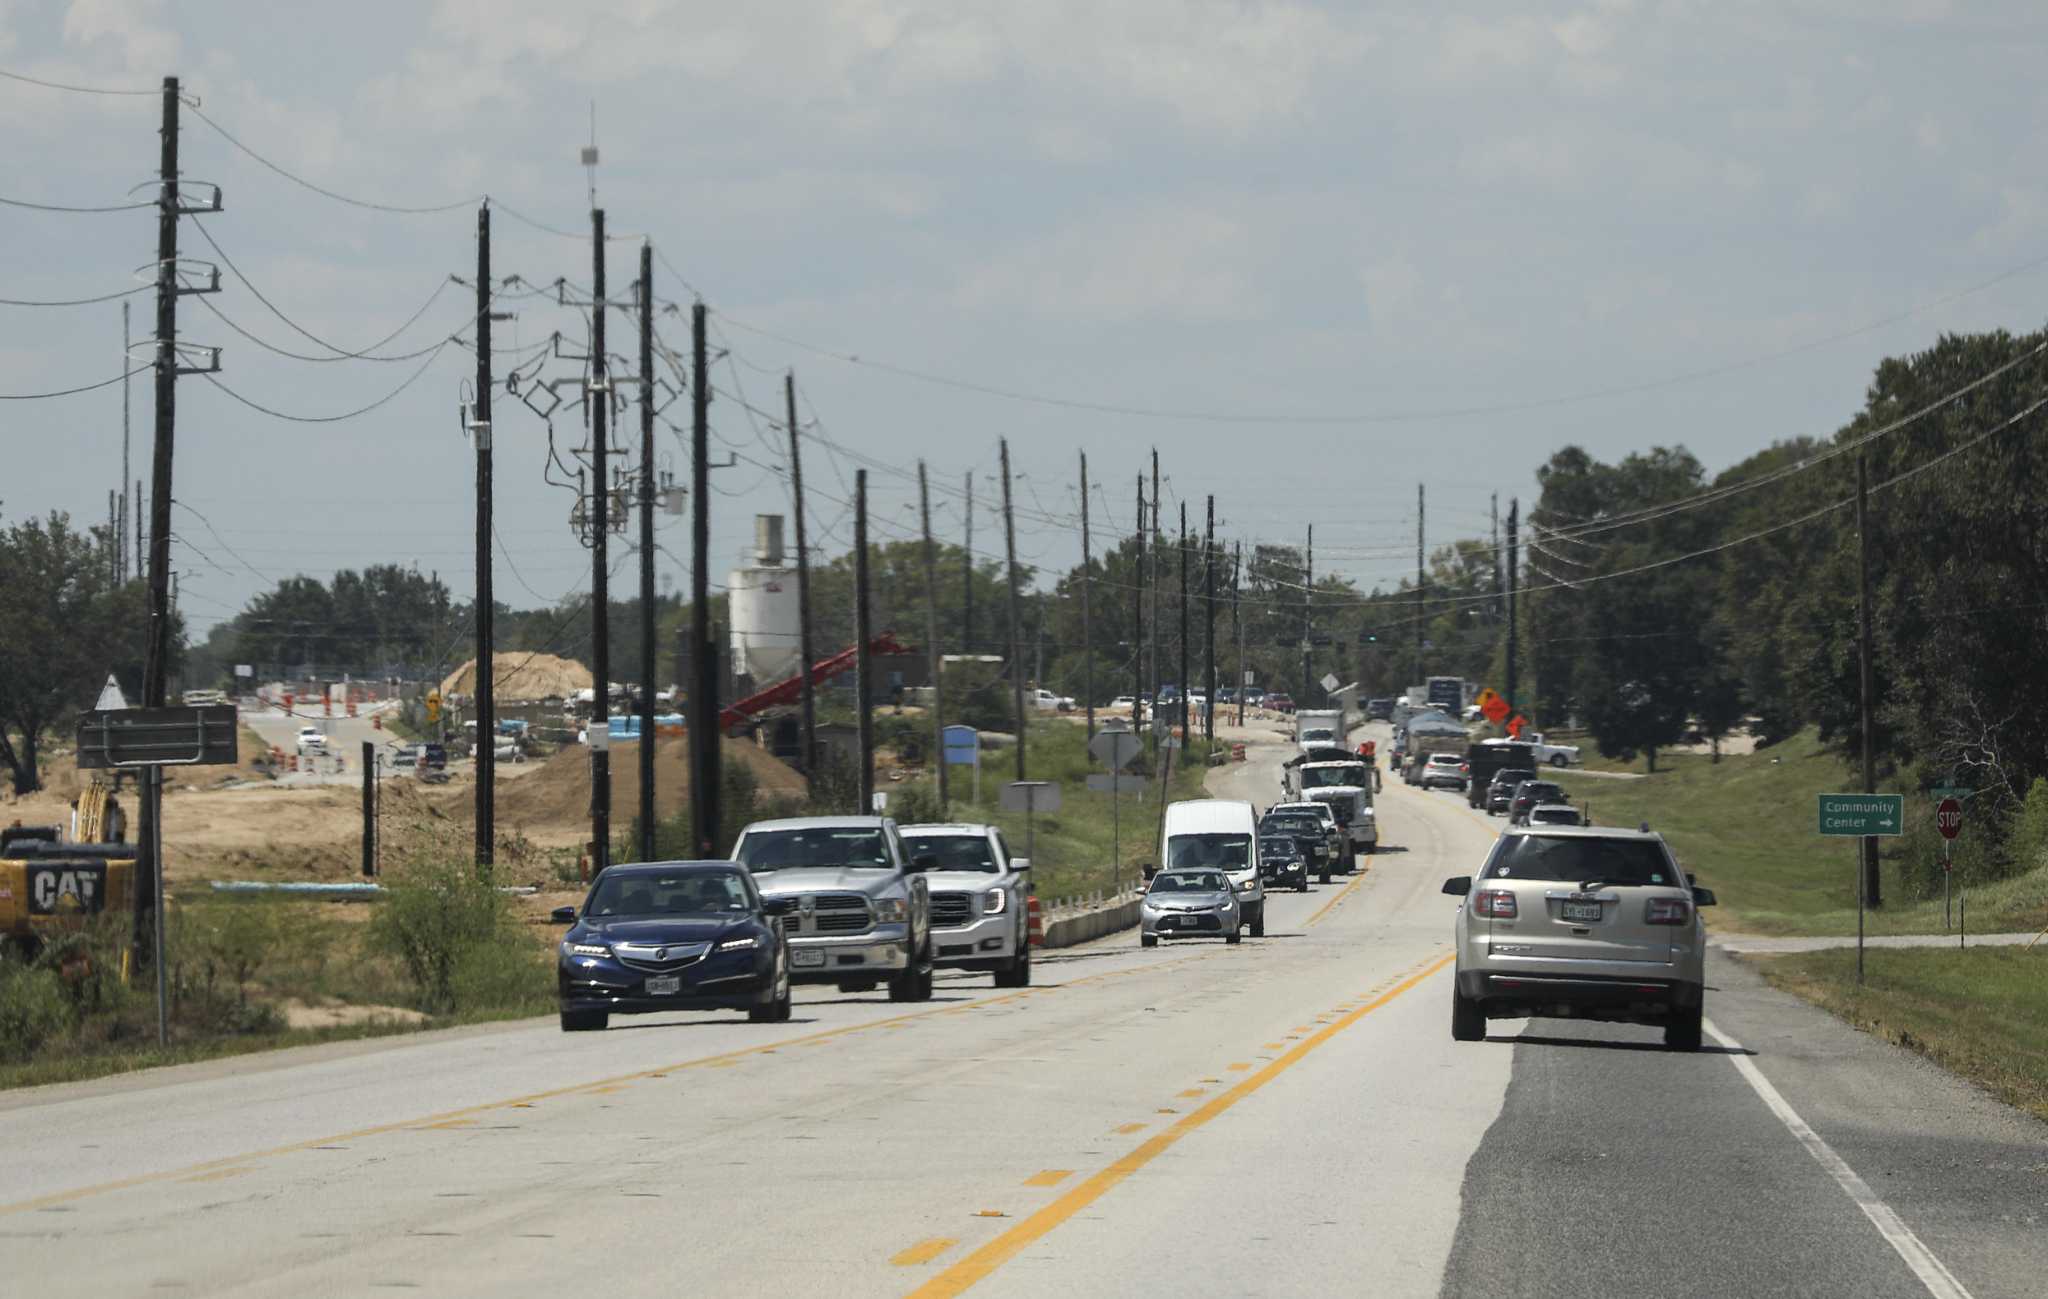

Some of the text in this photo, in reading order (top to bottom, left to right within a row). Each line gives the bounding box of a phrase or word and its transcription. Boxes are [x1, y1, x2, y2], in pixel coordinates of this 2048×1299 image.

[1826, 801, 1894, 815] Community
[1826, 818, 1866, 828] Center
[1939, 811, 1961, 828] STOP
[35, 871, 97, 909] CAT
